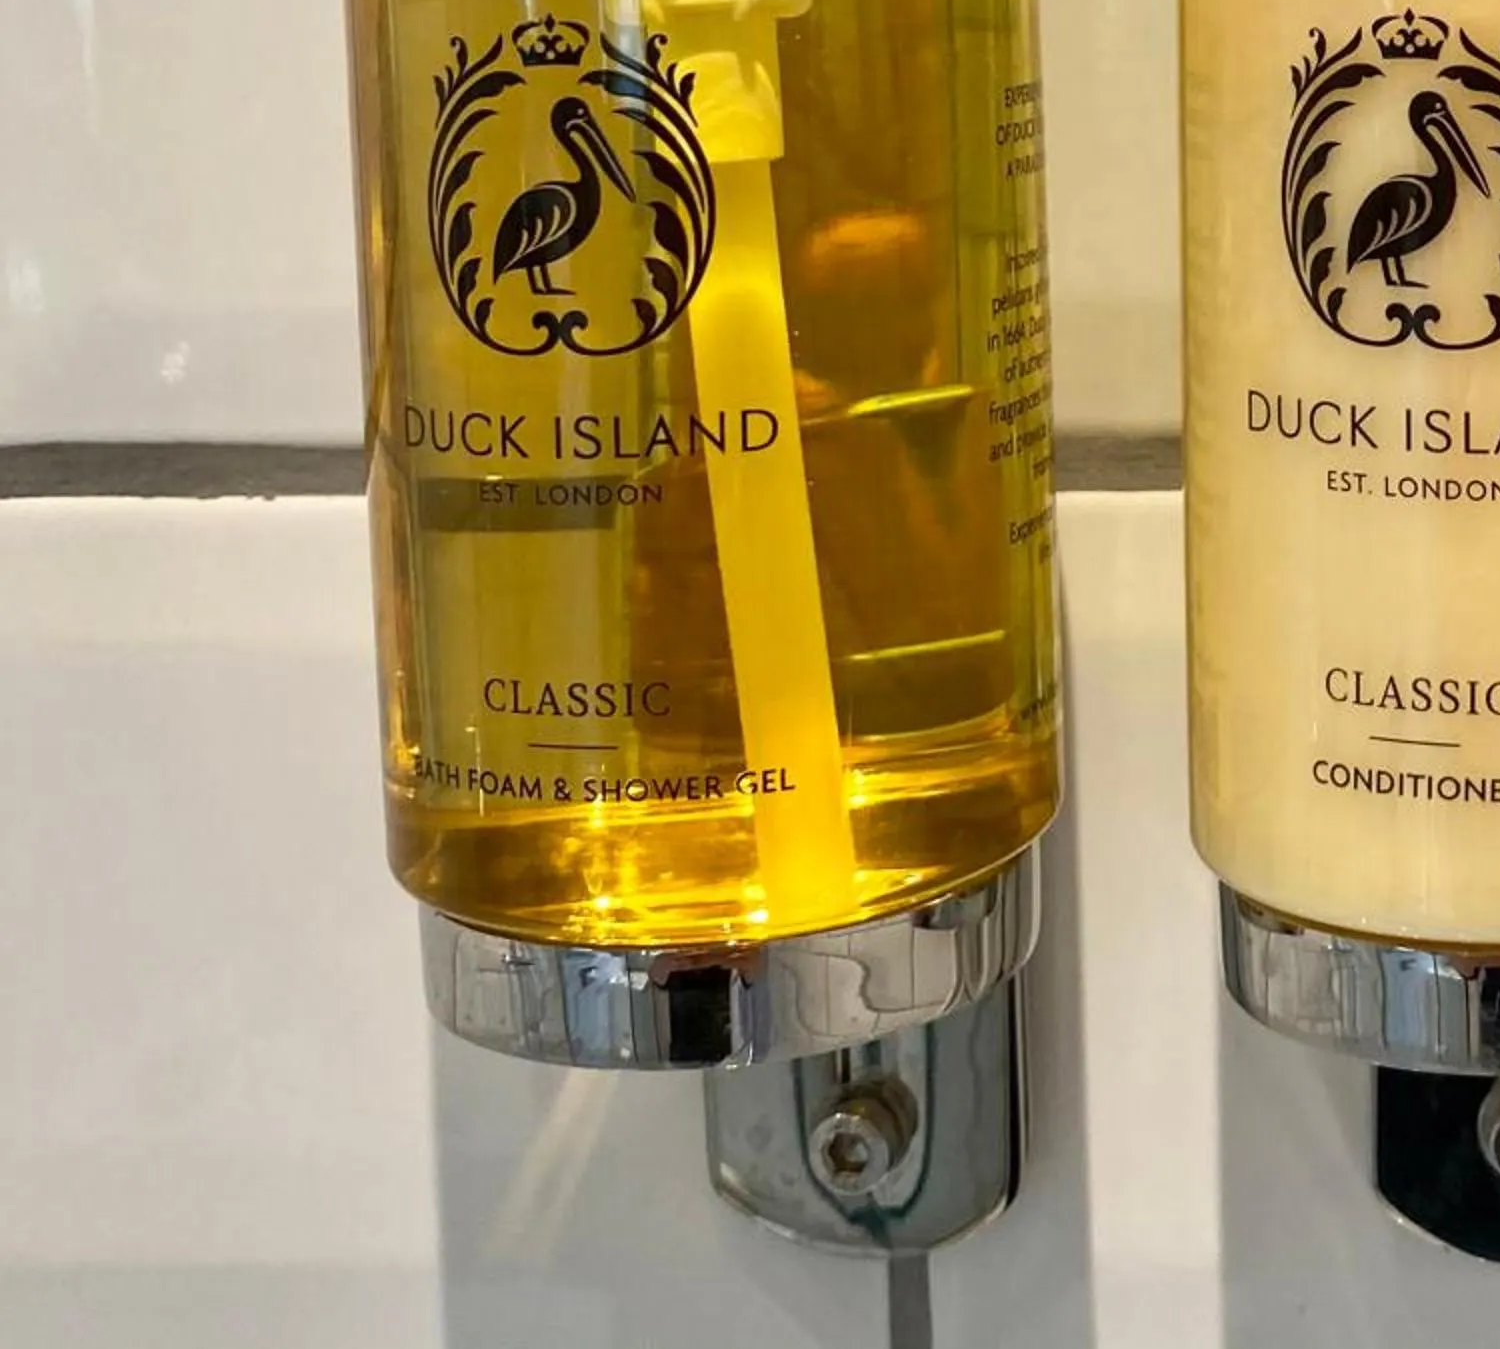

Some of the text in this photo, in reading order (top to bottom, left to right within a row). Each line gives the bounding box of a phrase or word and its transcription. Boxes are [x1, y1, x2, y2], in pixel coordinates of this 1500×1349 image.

[403, 405, 779, 460] DUCK ISLAND
[1247, 389, 1379, 450] DUCK
[534, 484, 663, 507] LONDON
[1326, 470, 1373, 495] EST.
[483, 678, 672, 718] CLASSIC
[467, 768, 543, 801] FOAM
[553, 777, 573, 802] &
[582, 773, 722, 803] SHOWER
[735, 767, 797, 795] GEL
